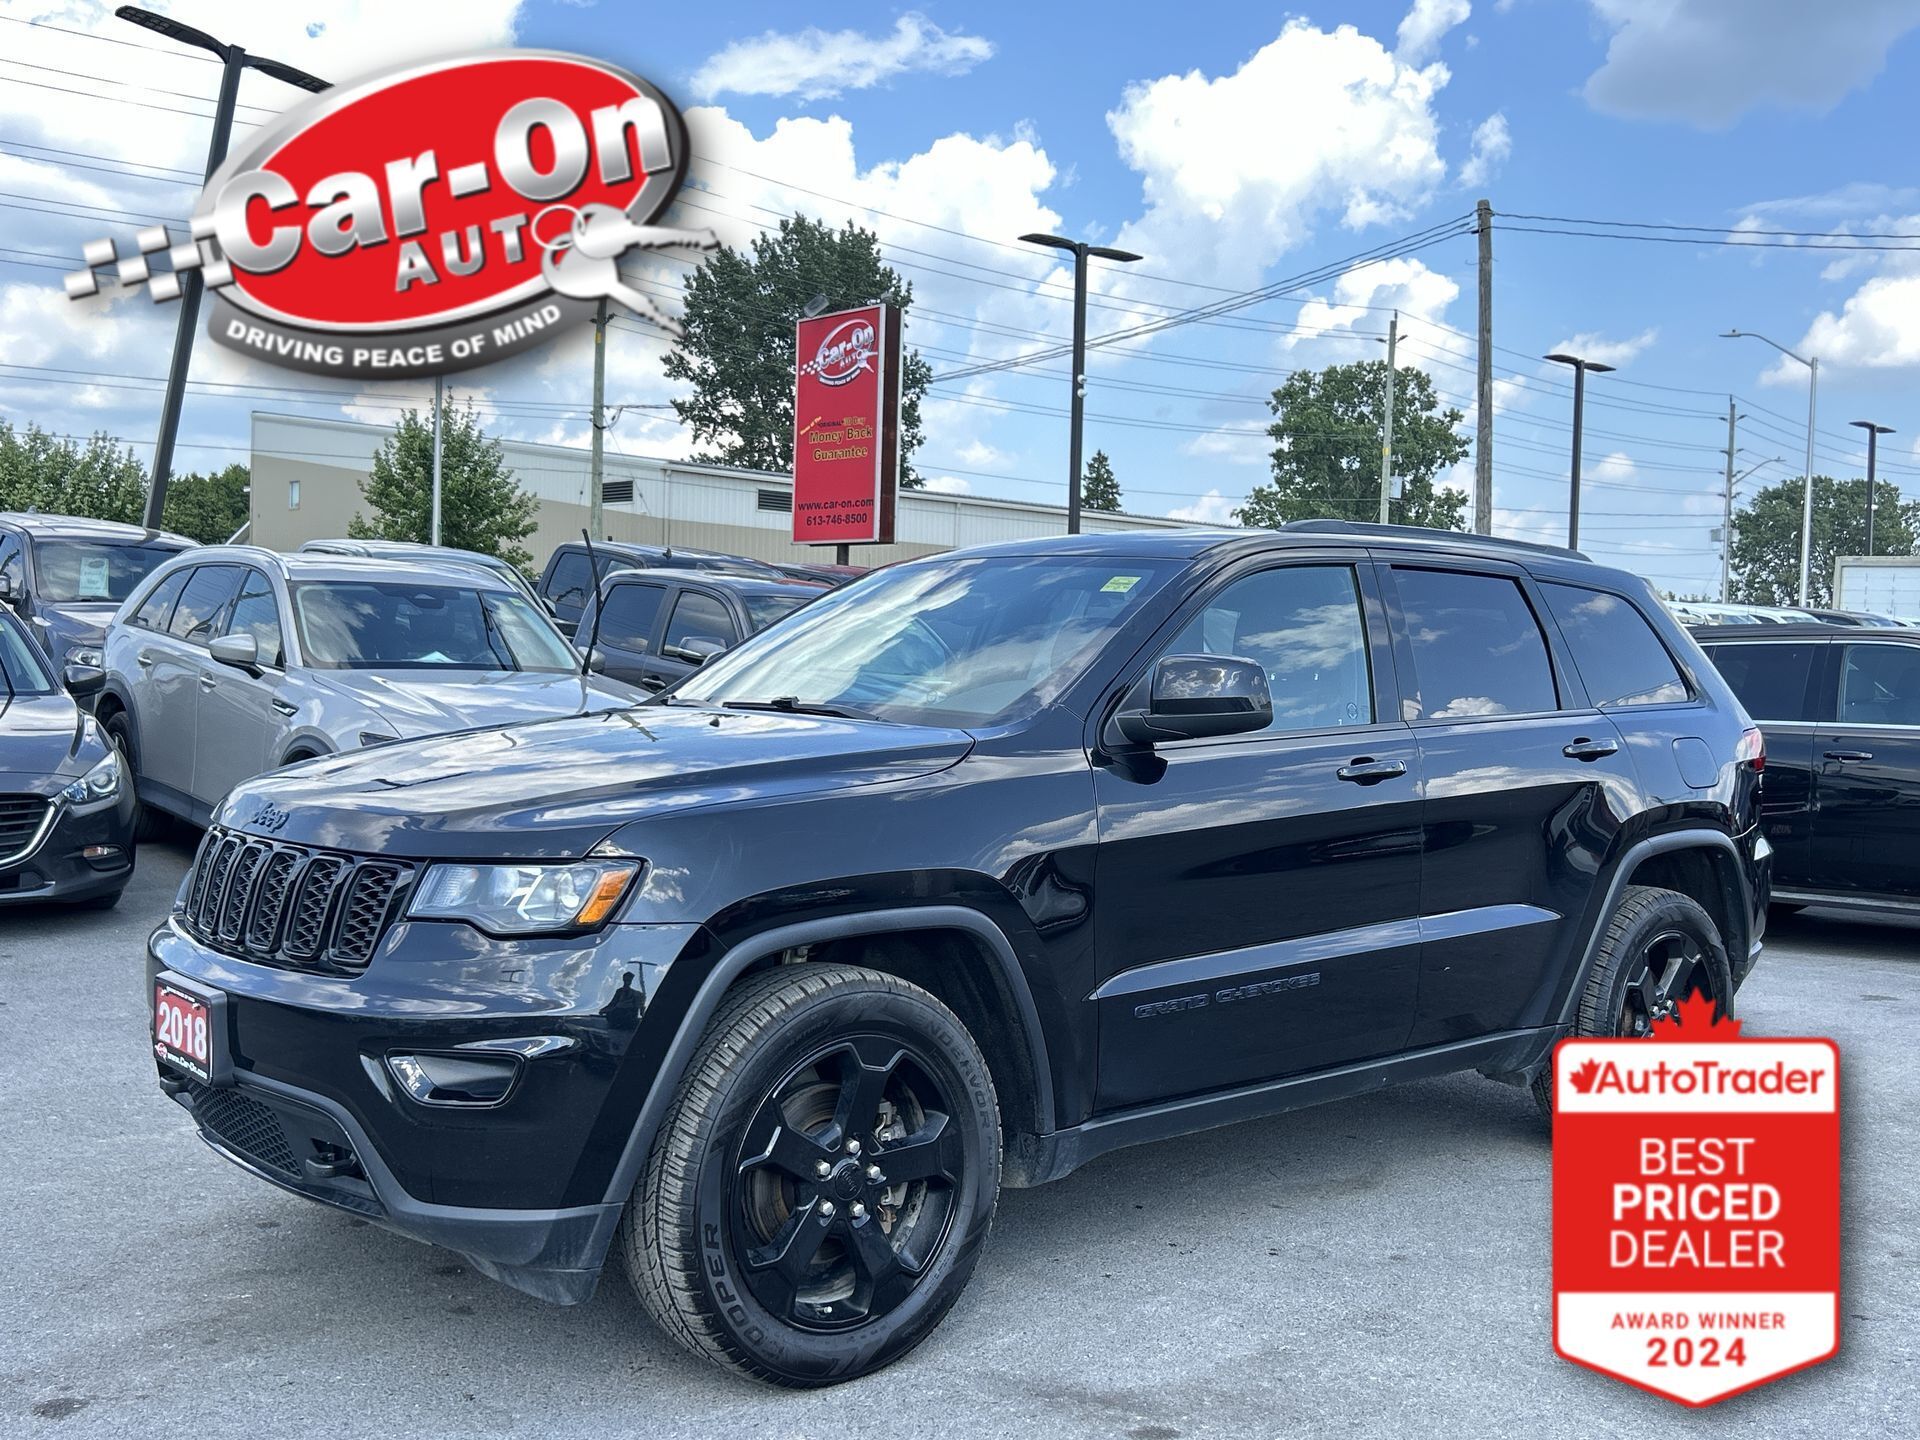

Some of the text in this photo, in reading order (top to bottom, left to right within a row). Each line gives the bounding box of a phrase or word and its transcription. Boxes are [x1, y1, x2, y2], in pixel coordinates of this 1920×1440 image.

[818, 326, 874, 369] Car-On
[809, 425, 873, 444] Money Back
[813, 446, 869, 461] Guarantee
[798, 499, 874, 510] www.car-on.com
[806, 513, 868, 526] 613-746-8500
[251, 802, 290, 834] Jeep
[1134, 972, 1321, 1019] GRAND CHEROKEE
[158, 1001, 207, 1060] 2018
[704, 1223, 780, 1356] OOPER
